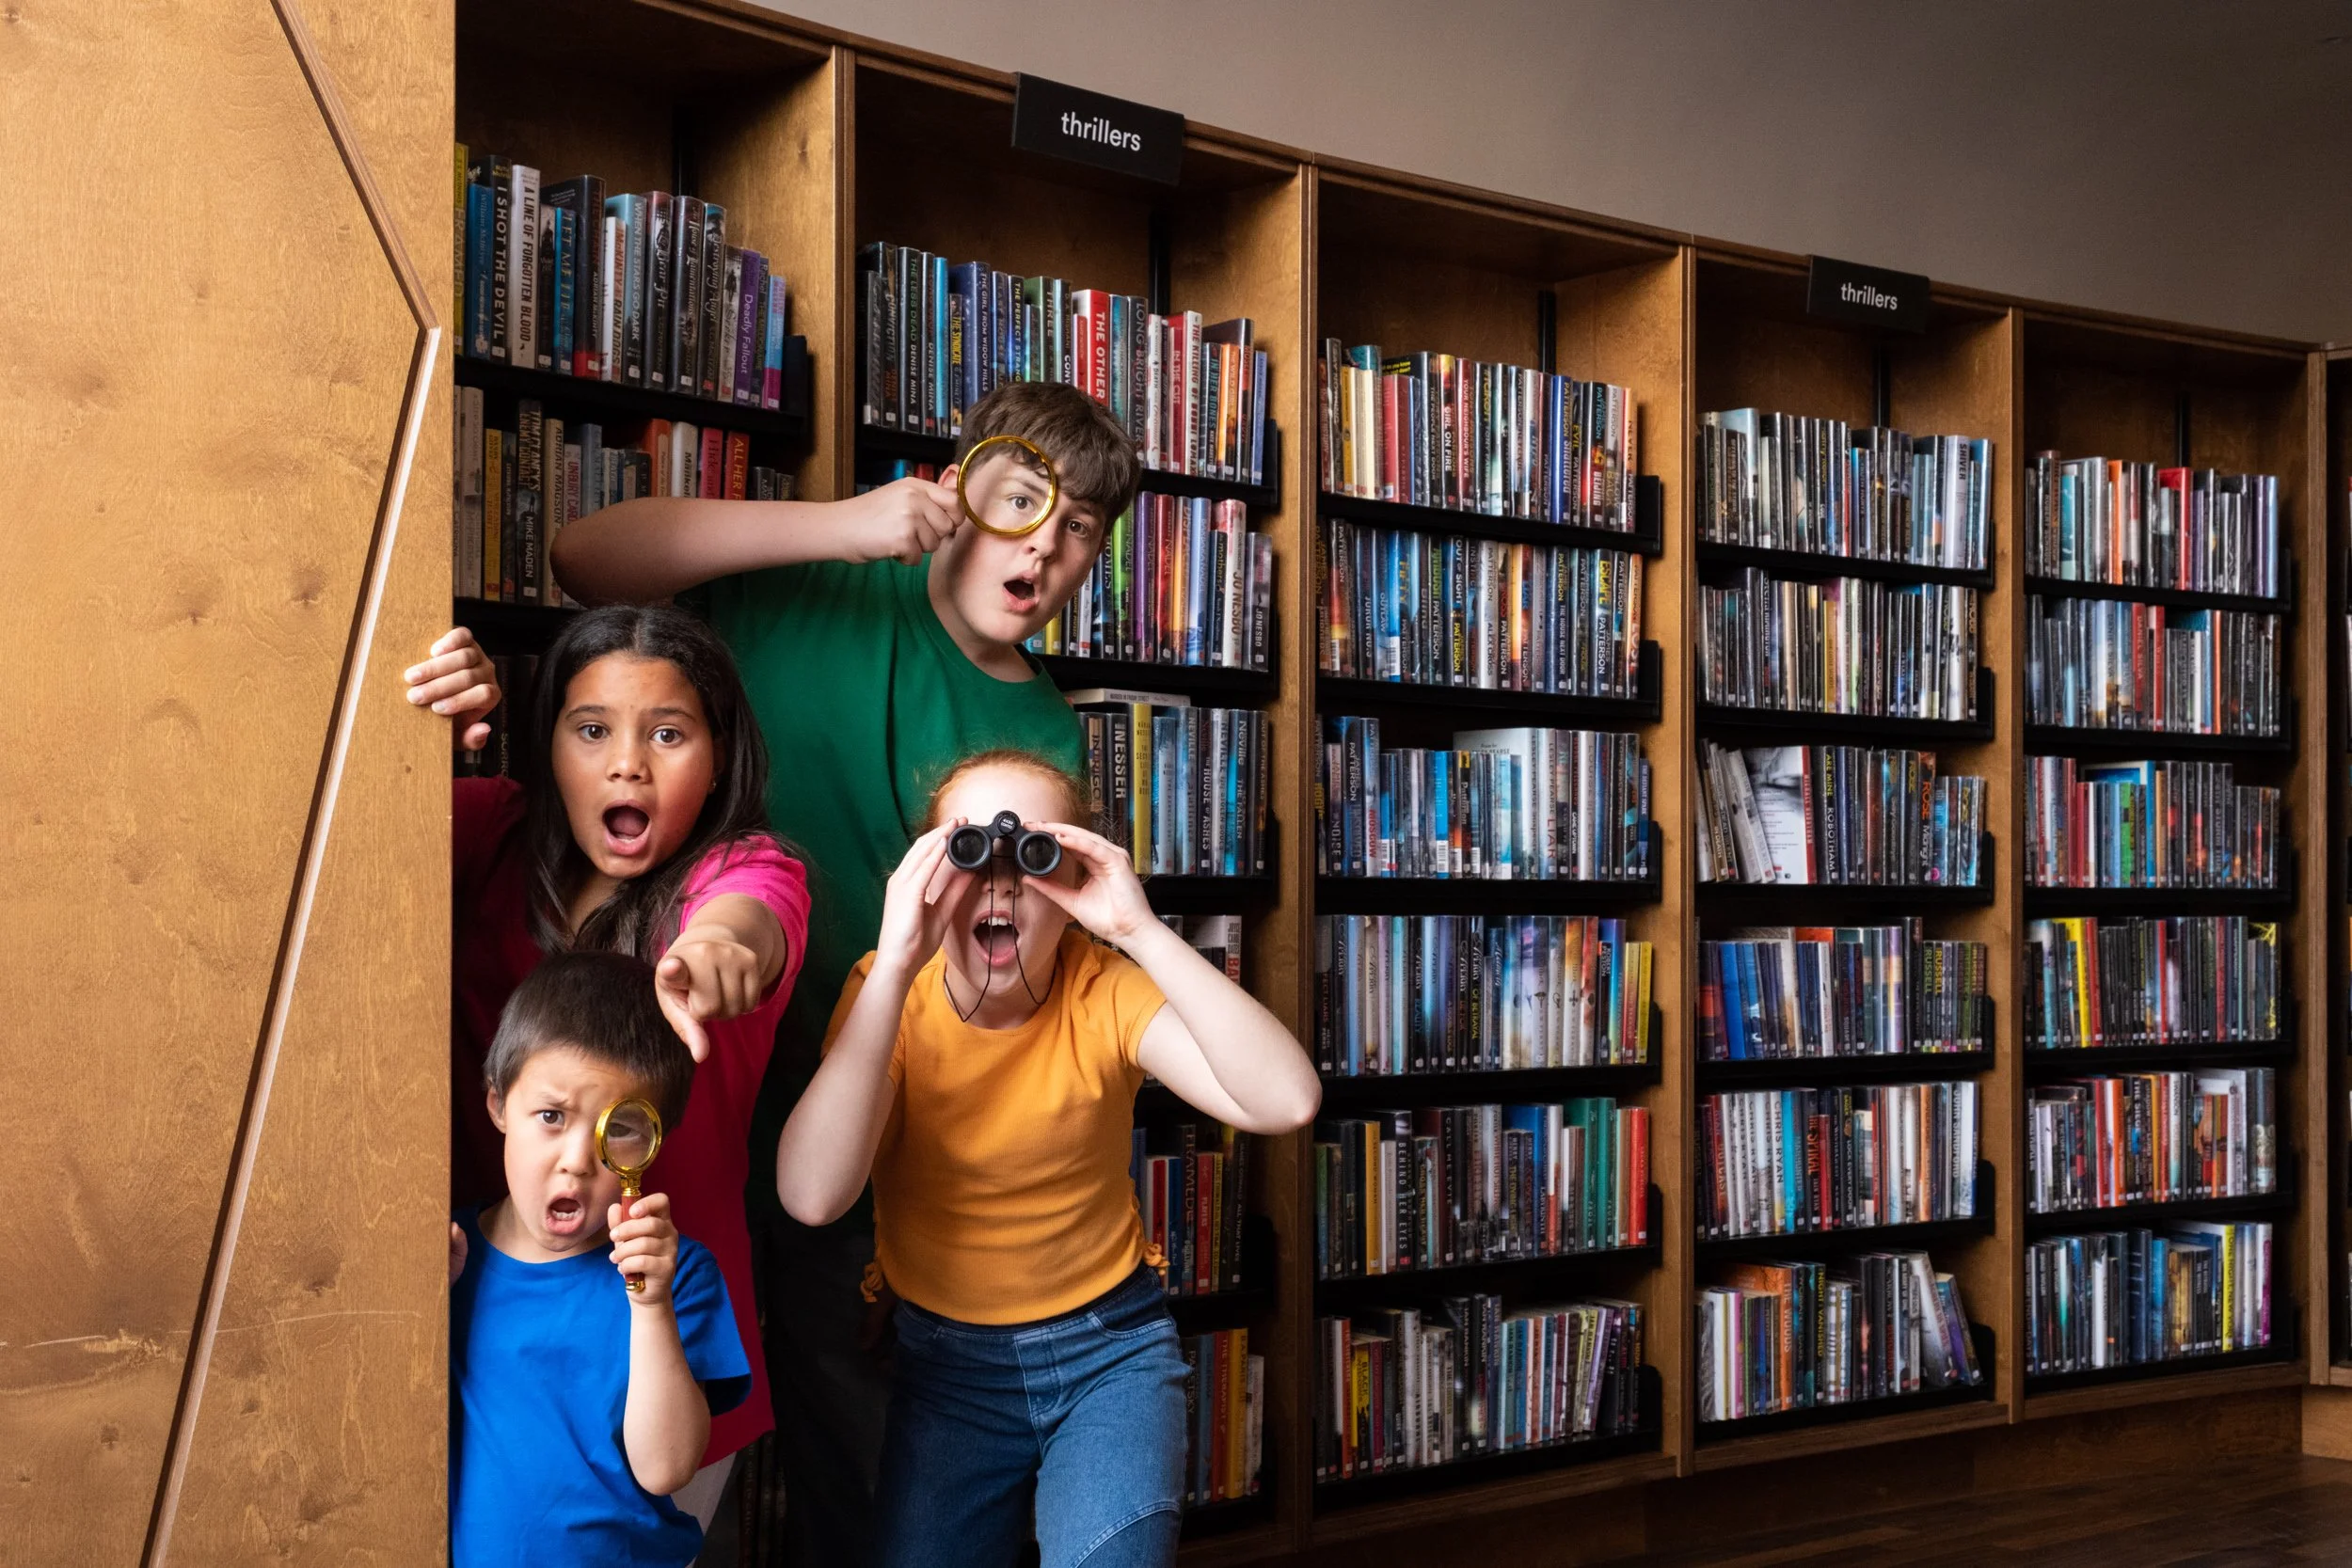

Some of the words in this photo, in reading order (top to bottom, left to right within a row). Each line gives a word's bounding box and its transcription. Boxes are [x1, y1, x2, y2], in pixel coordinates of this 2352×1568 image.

[1060, 111, 1142, 151] thrillers
[495, 197, 506, 245] SHOT
[523, 197, 534, 223] LINE
[633, 202, 642, 235] WHEN
[523, 226, 533, 236] OF
[633, 237, 642, 257] THE
[495, 249, 505, 281] THE
[521, 242, 532, 302] FORGOTTEN
[632, 258, 642, 290] STARS
[612, 299, 623, 327] RAIN
[632, 293, 641, 309] GO
[703, 291, 719, 322] Angel
[740, 293, 754, 333] Deadly
[1840, 282, 1898, 310] thrillers
[493, 288, 505, 339] DEVIL
[519, 305, 532, 341] BLOOD
[631, 311, 641, 340] DARK
[1096, 311, 1105, 341] THE
[1136, 303, 1145, 344] LONG
[612, 332, 621, 364] DOGS
[1192, 325, 1200, 341] THE
[740, 337, 752, 373] Fallout
[1173, 350, 1181, 360] IN
[1191, 345, 1200, 383] KILLING
[1211, 358, 1218, 370] IN
[1096, 346, 1105, 399] OTHER
[1136, 349, 1145, 400] BRIGHT
[1210, 372, 1218, 391] HER
[1191, 388, 1199, 400] OF
[519, 413, 529, 442] ENEMY
[531, 410, 542, 434] TOM
[1136, 404, 1144, 442] RIVER
[1209, 395, 1217, 428] BONES
[519, 445, 529, 486] CONTACT
[530, 437, 542, 491] CLANCY'S
[554, 427, 563, 471] ADRIAN
[734, 438, 743, 461] ALL
[1959, 443, 1967, 480] SHIVER
[567, 461, 579, 496] UNBURY
[732, 464, 743, 489] HER
[1593, 471, 1602, 505] BEIJING
[554, 474, 563, 524] MAGSON
[525, 516, 534, 540] MIKE
[525, 542, 533, 578] MADEN
[1599, 560, 1611, 605] ESCAPE
[1237, 721, 1247, 766] Neville
[1092, 735, 1102, 800] INTRIGO
[1114, 729, 1126, 799] NESSER
[1202, 768, 1211, 803] HOUSE
[1921, 782, 1931, 820] ROSE
[1202, 816, 1211, 850] ASHES
[1807, 1133, 1819, 1175] SPIRAL
